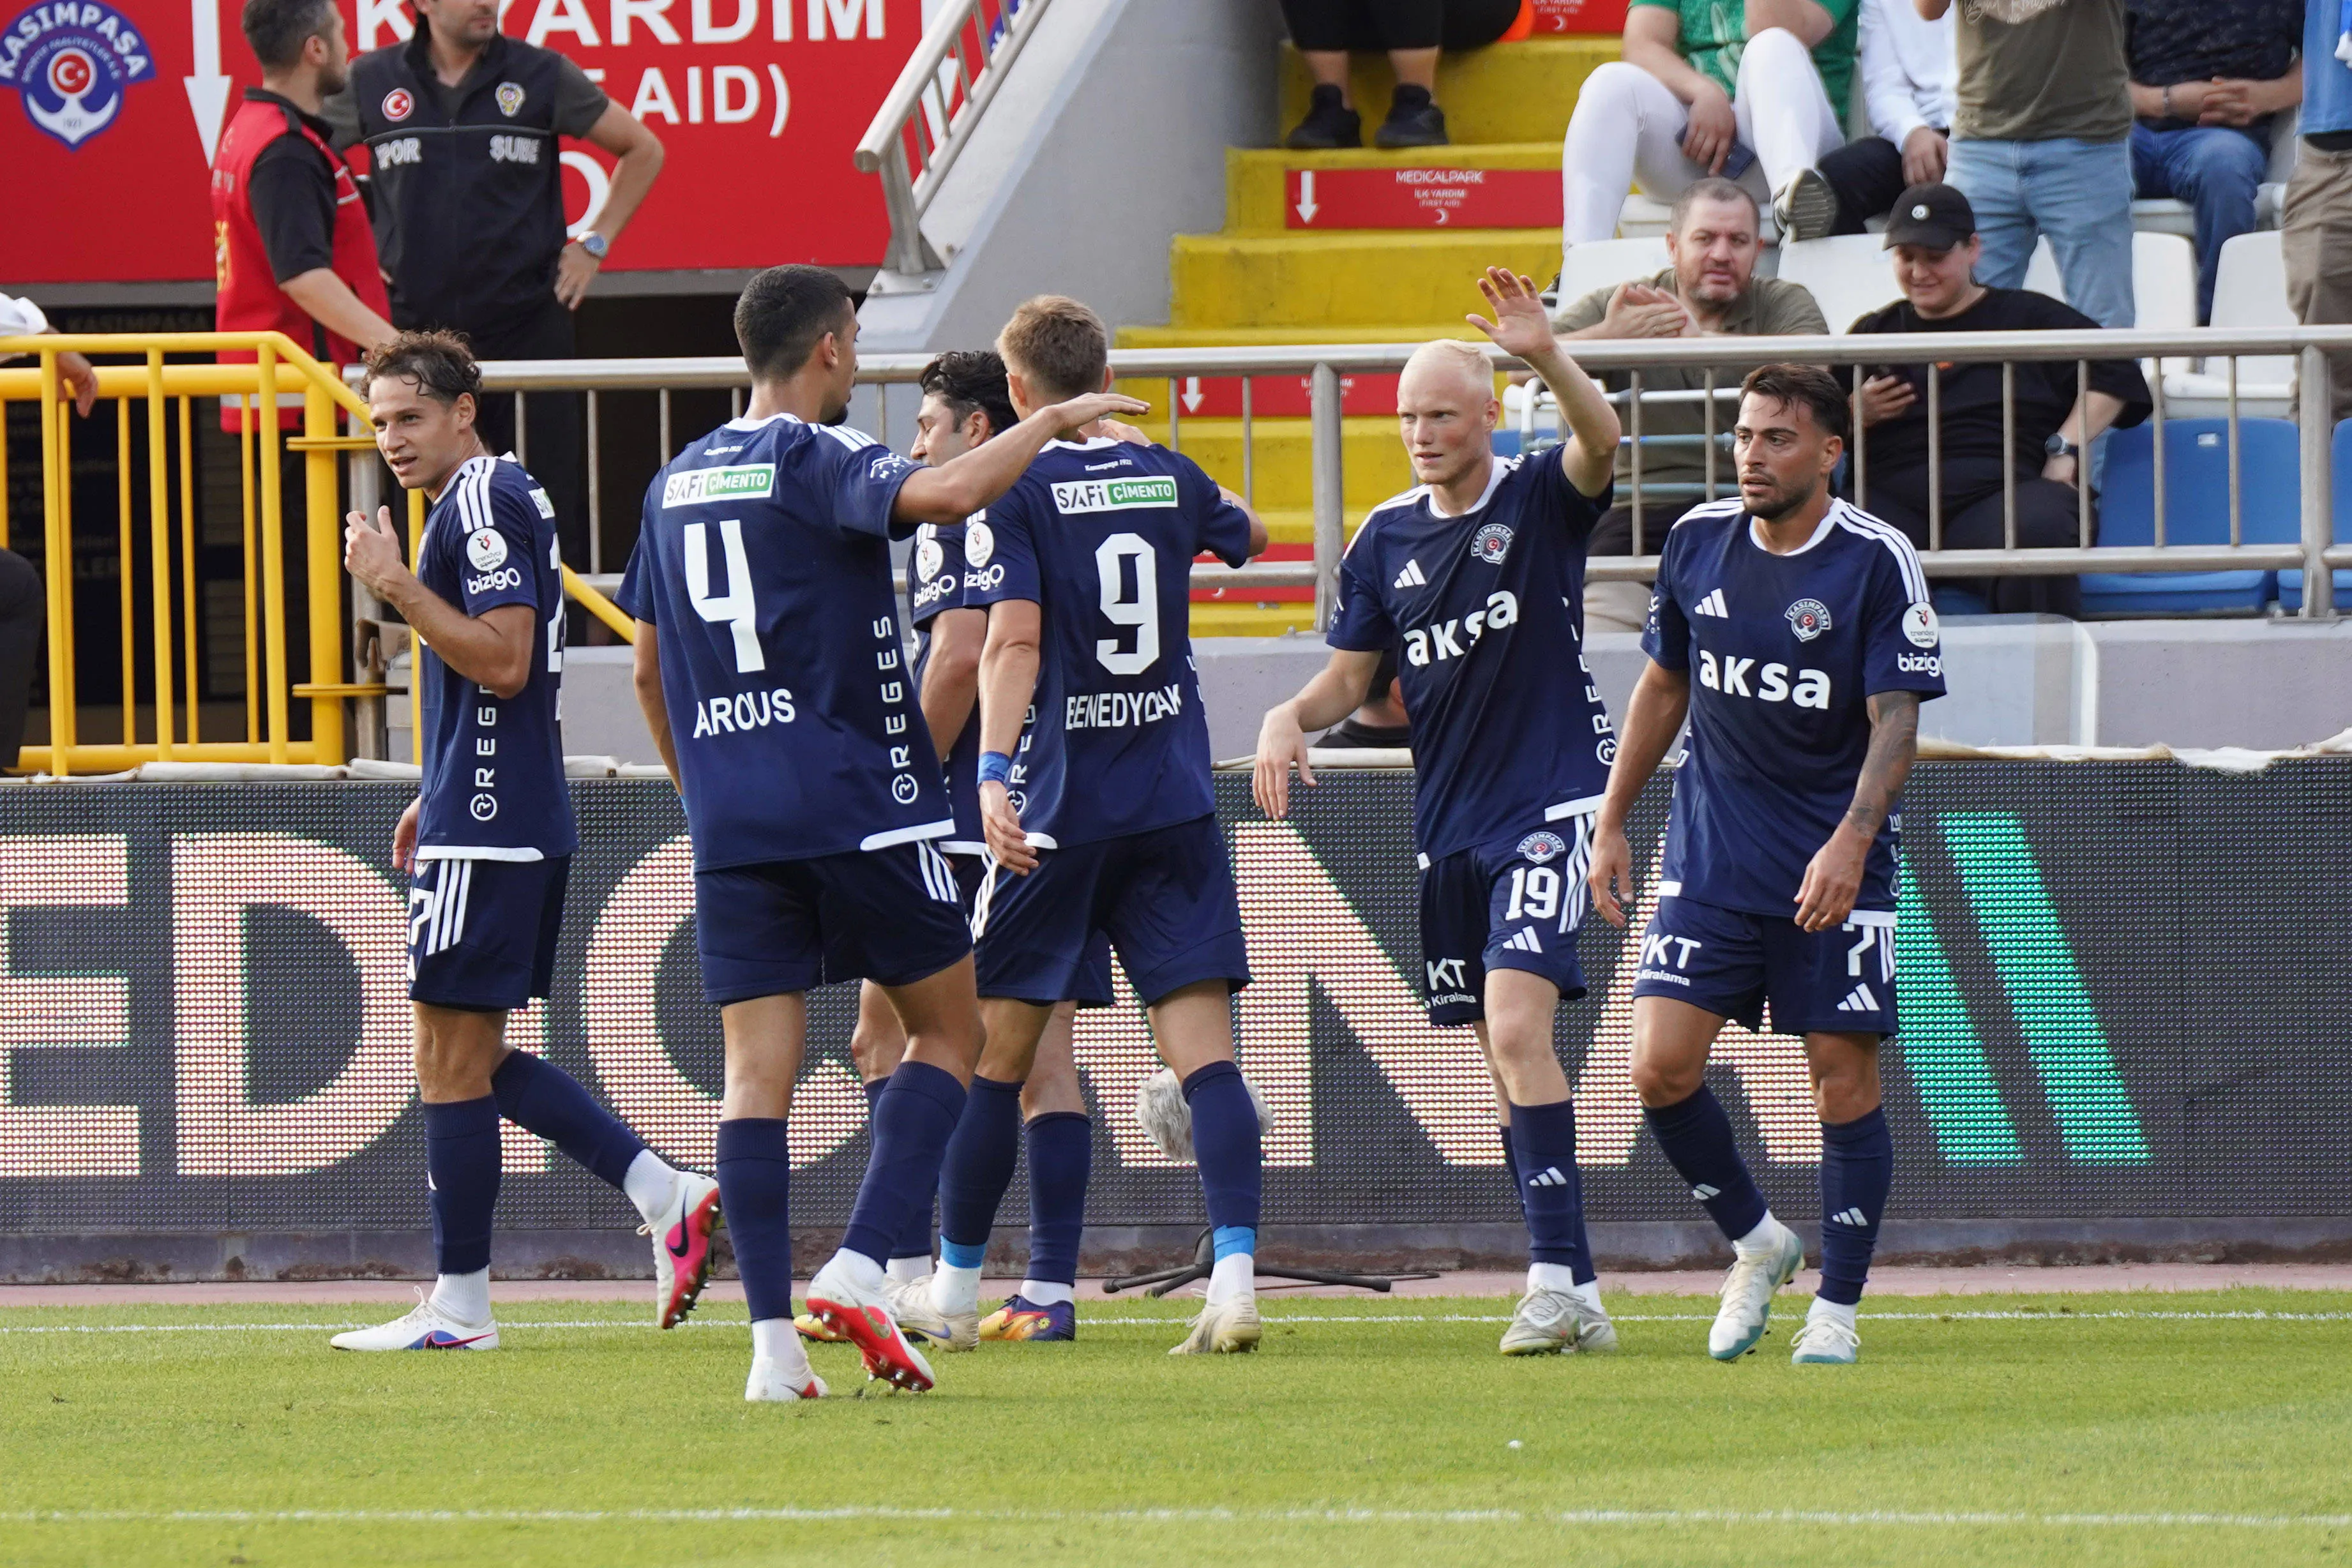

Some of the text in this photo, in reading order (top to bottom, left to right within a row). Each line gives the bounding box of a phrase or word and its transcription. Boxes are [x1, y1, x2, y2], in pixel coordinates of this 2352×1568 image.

[497, 0, 885, 46] ARDIM
[632, 64, 790, 138] AID)
[1396, 170, 1484, 184] MEDICALPARK
[1414, 188, 1465, 199] İLK YARDIM
[684, 519, 765, 673] 4
[964, 564, 1004, 591] izigo
[1095, 532, 1160, 675] 9
[1403, 591, 1518, 667] aksa
[1699, 649, 1831, 709] aksa
[693, 688, 795, 739] AROUS
[1505, 868, 1560, 921] 19
[1841, 924, 1876, 977] 7
